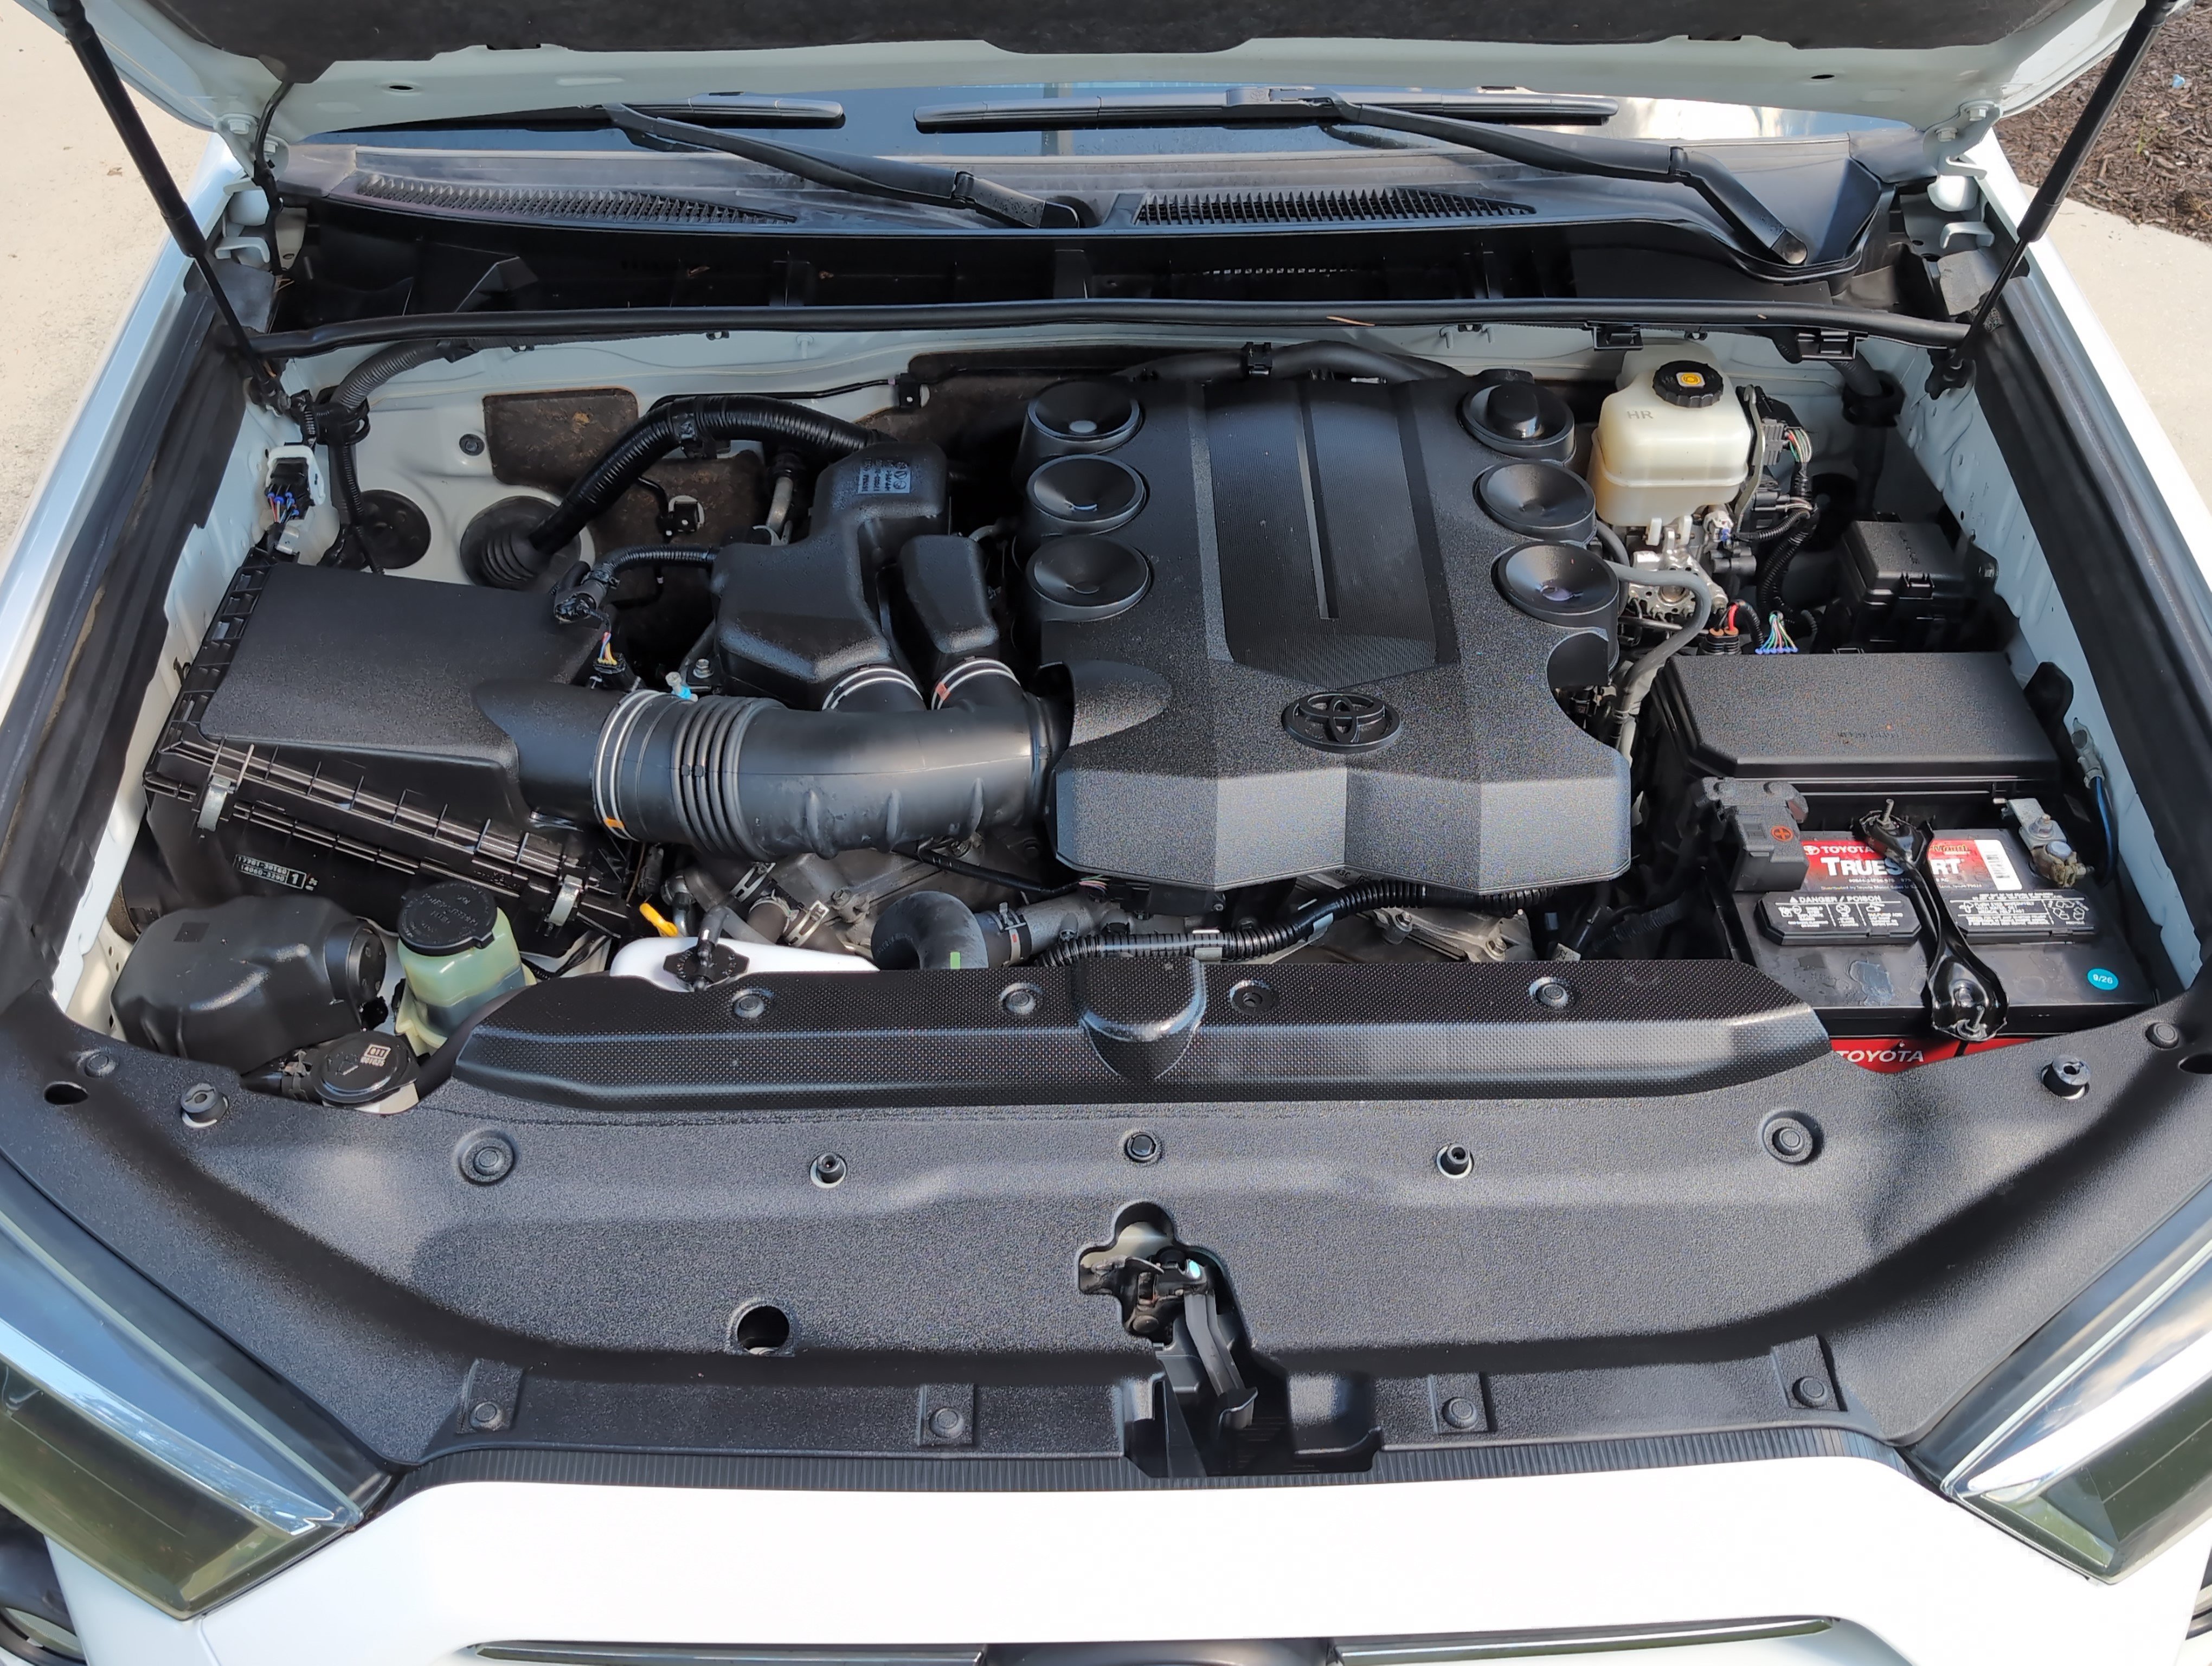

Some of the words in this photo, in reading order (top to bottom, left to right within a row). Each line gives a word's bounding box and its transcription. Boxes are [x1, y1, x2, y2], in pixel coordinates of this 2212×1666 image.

[1627, 411, 1653, 419] HR
[1820, 845, 1876, 854] TOYOTA
[1820, 856, 1962, 876] TRUESRT
[292, 874, 299, 885] 1
